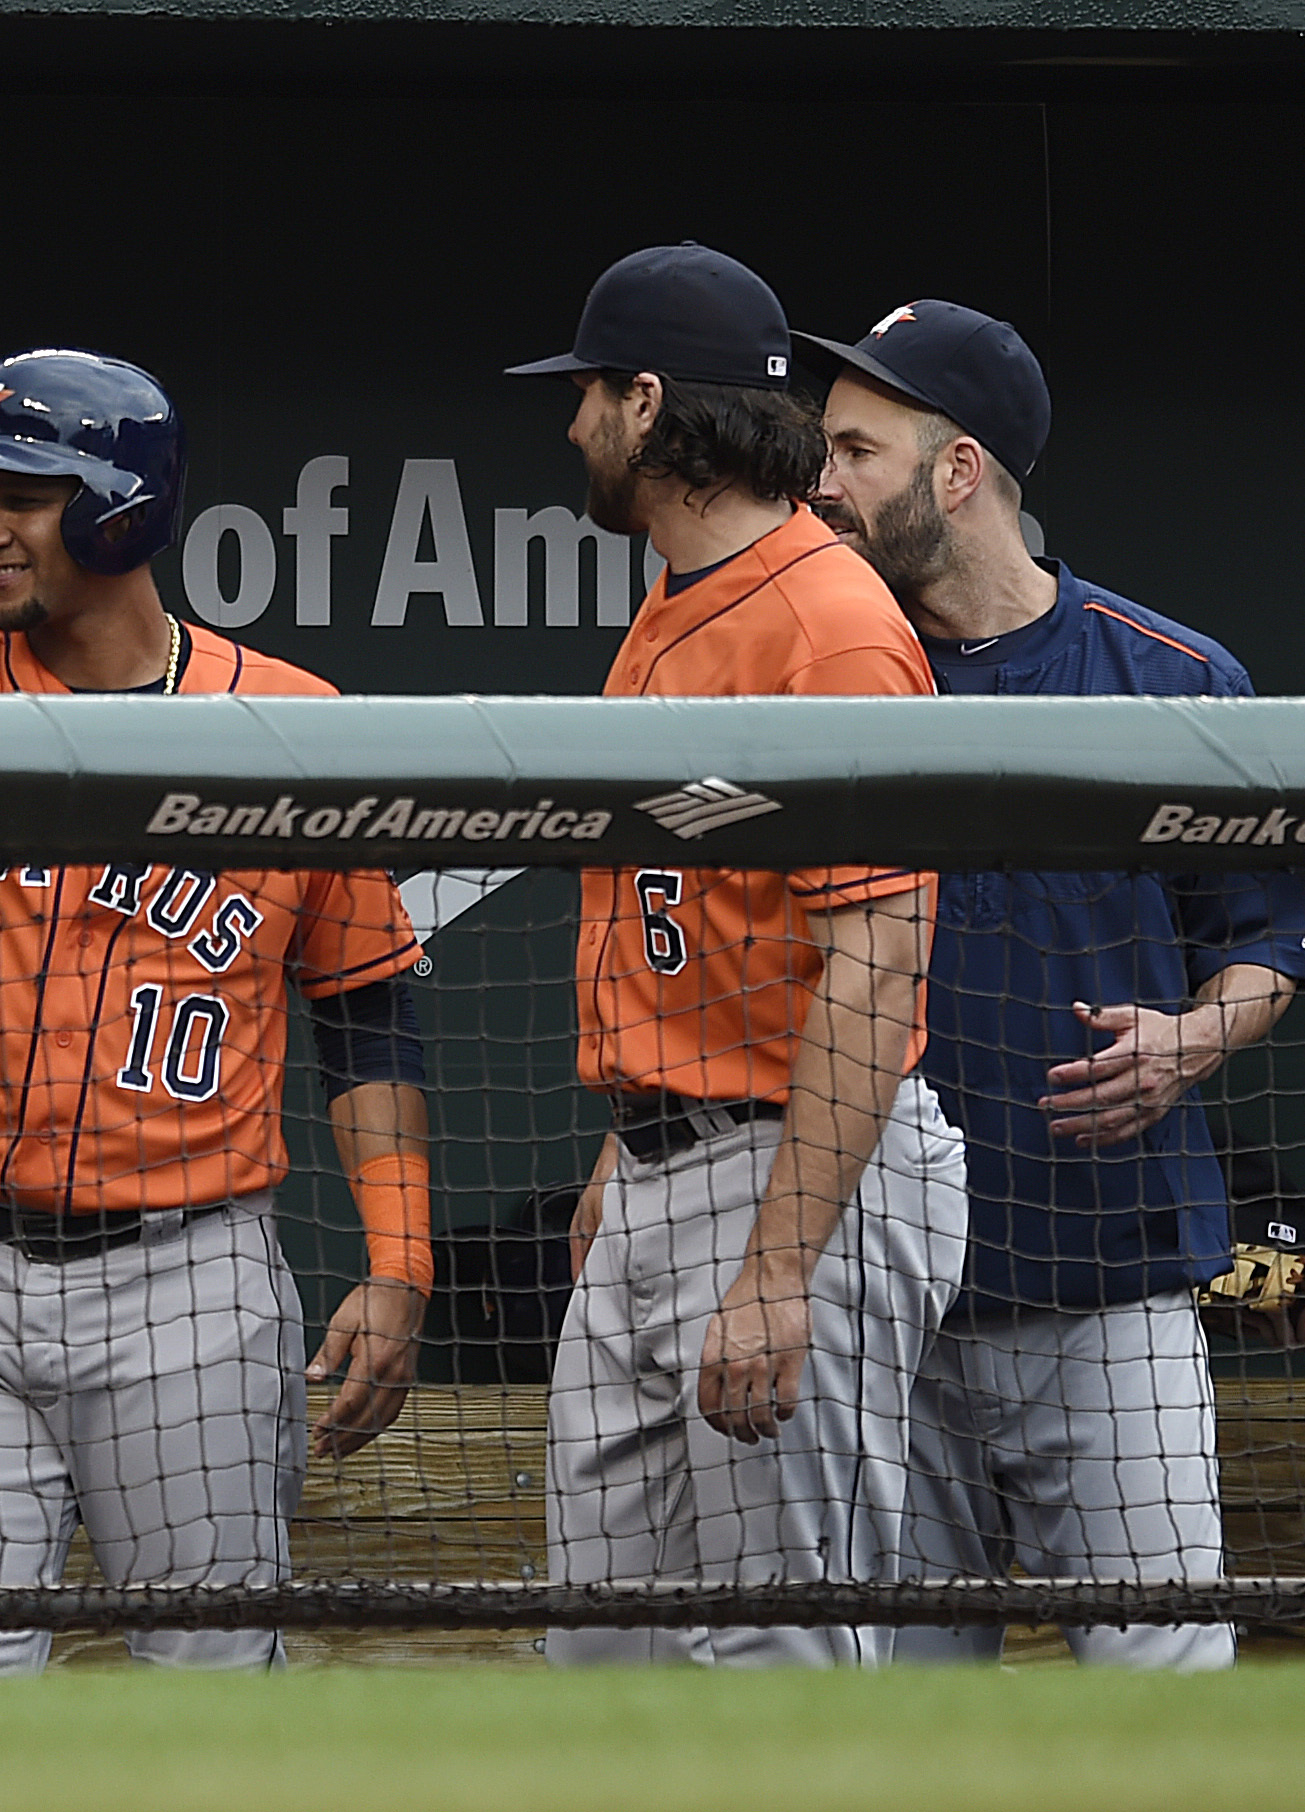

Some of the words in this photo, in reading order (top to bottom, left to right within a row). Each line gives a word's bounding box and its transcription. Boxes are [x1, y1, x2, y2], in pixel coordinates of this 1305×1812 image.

[182, 455, 348, 628] of
[146, 793, 306, 838] Bank
[301, 797, 379, 839] of
[363, 799, 614, 841] America
[1140, 804, 1298, 846] Bank
[634, 870, 688, 976] 6
[116, 983, 230, 1102] 10
